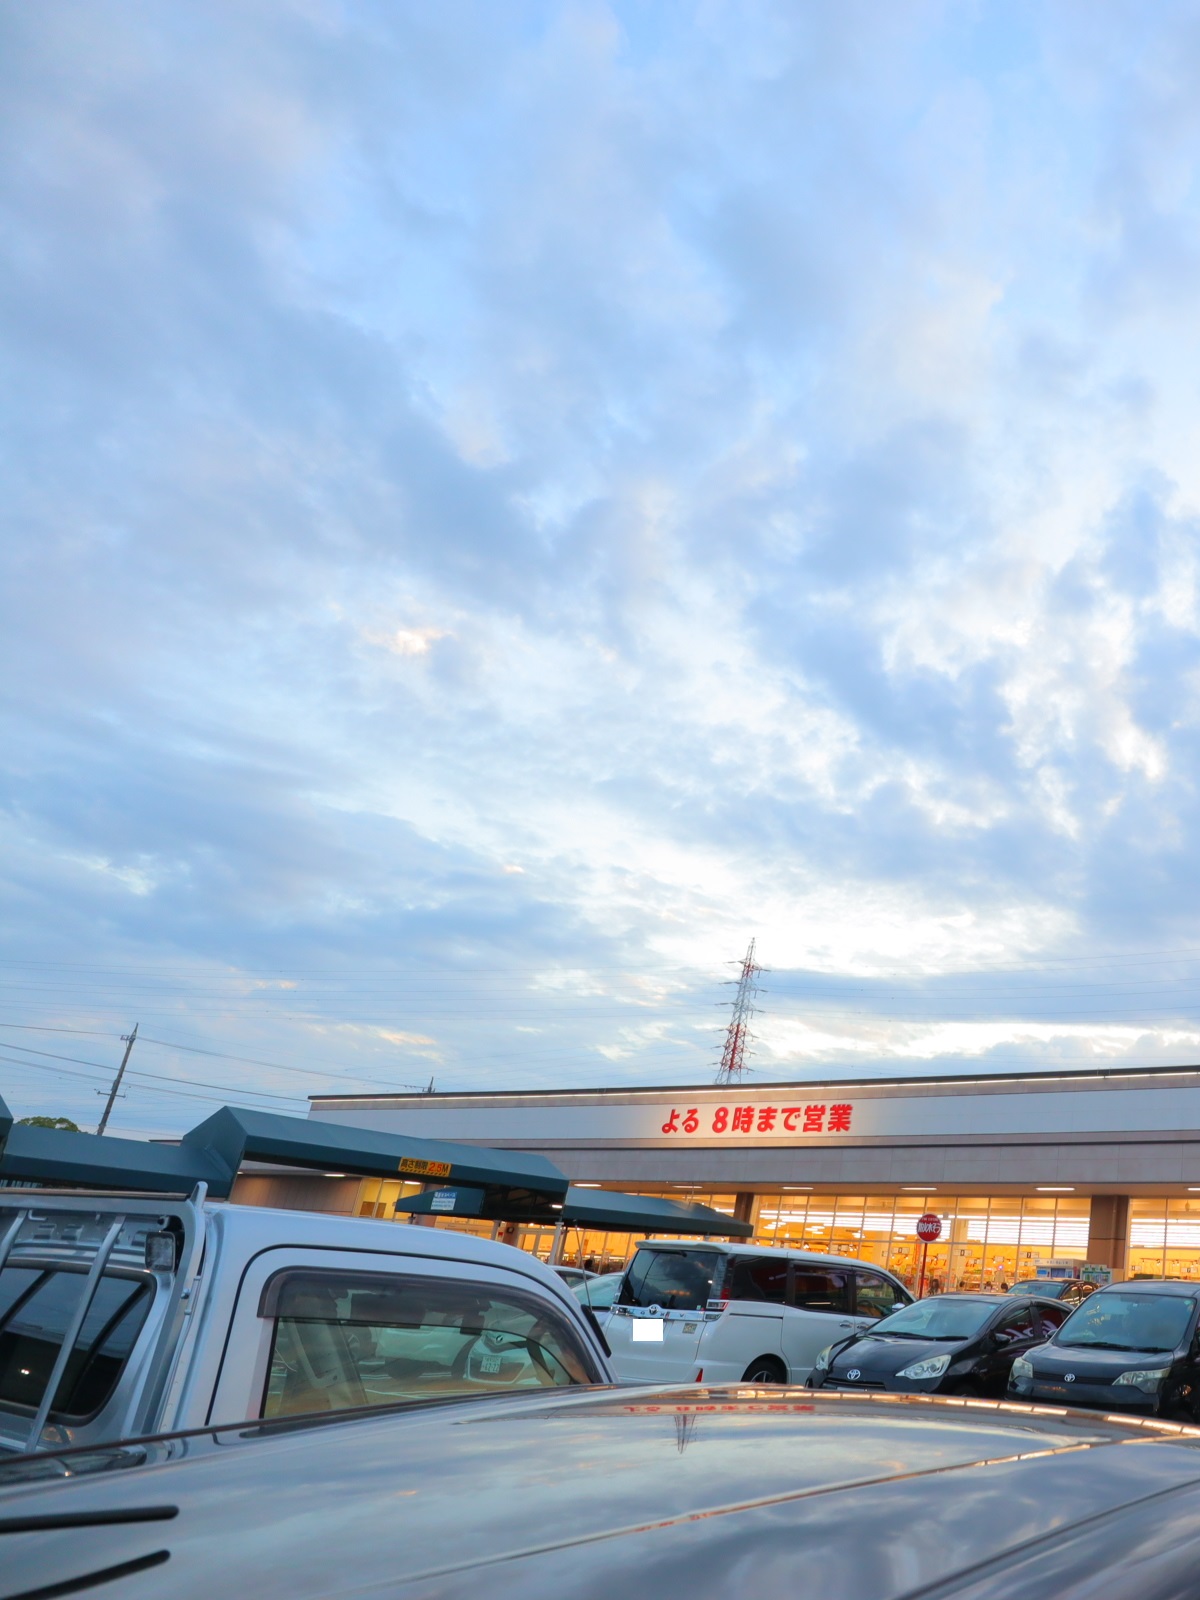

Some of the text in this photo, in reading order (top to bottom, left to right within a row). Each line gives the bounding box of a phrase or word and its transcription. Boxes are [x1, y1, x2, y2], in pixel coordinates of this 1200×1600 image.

[661, 1103, 853, 1134] よる 8時まで営業
